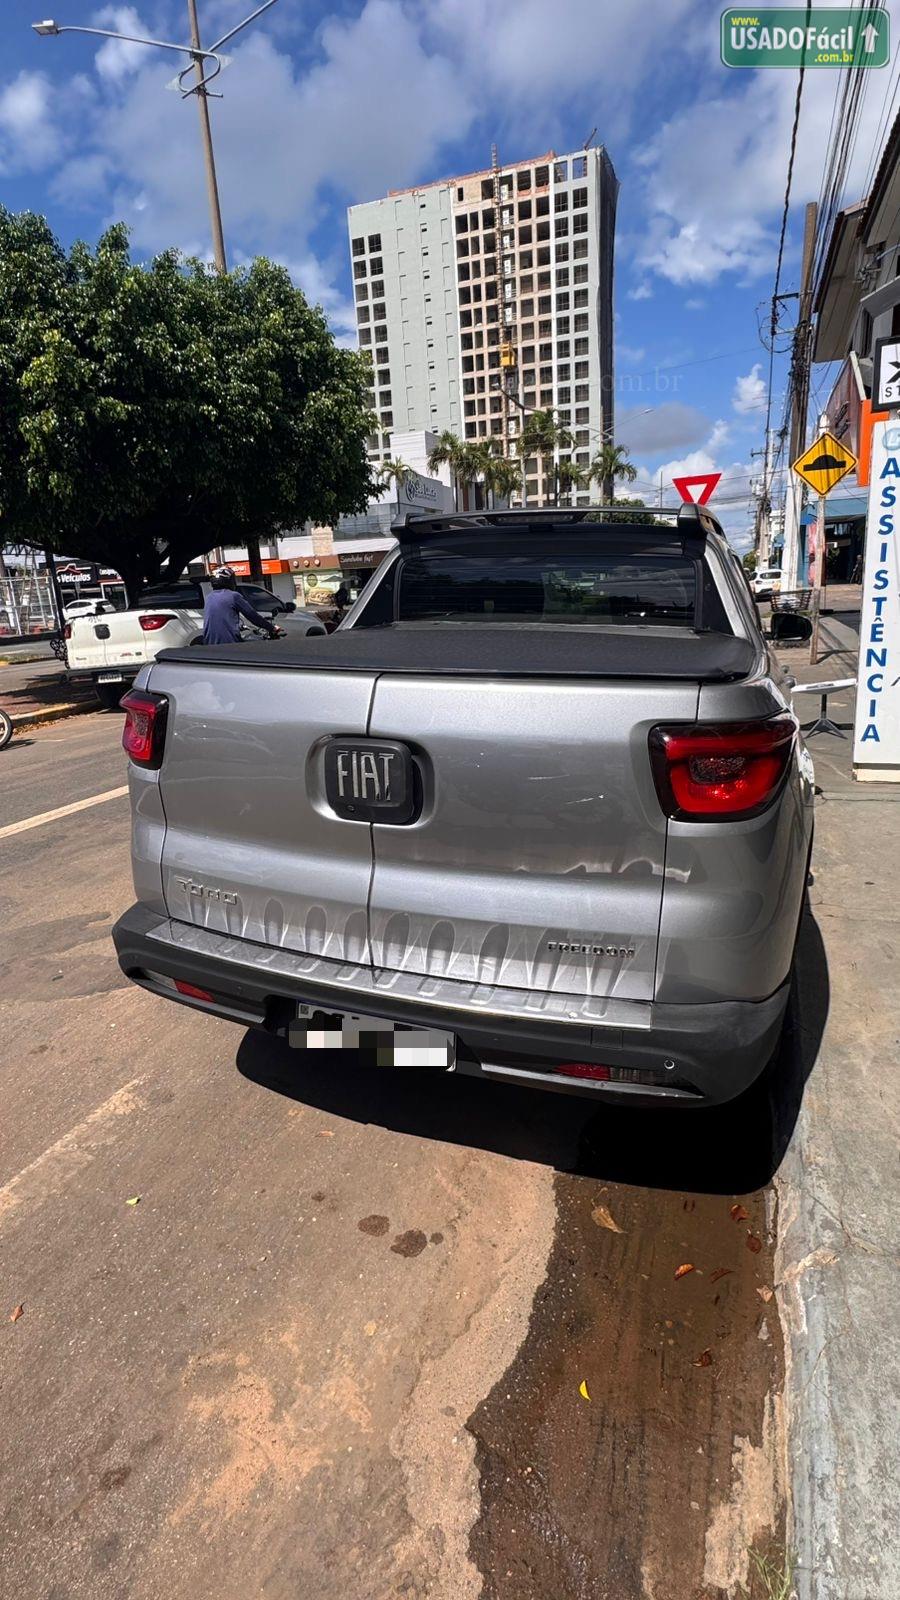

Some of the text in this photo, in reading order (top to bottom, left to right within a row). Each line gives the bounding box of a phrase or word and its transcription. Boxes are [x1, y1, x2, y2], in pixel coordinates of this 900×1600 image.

[860, 457, 900, 742] ASSISTÊNCIA
[336, 750, 395, 801] FIAT
[547, 941, 636, 958] FREEDOM
